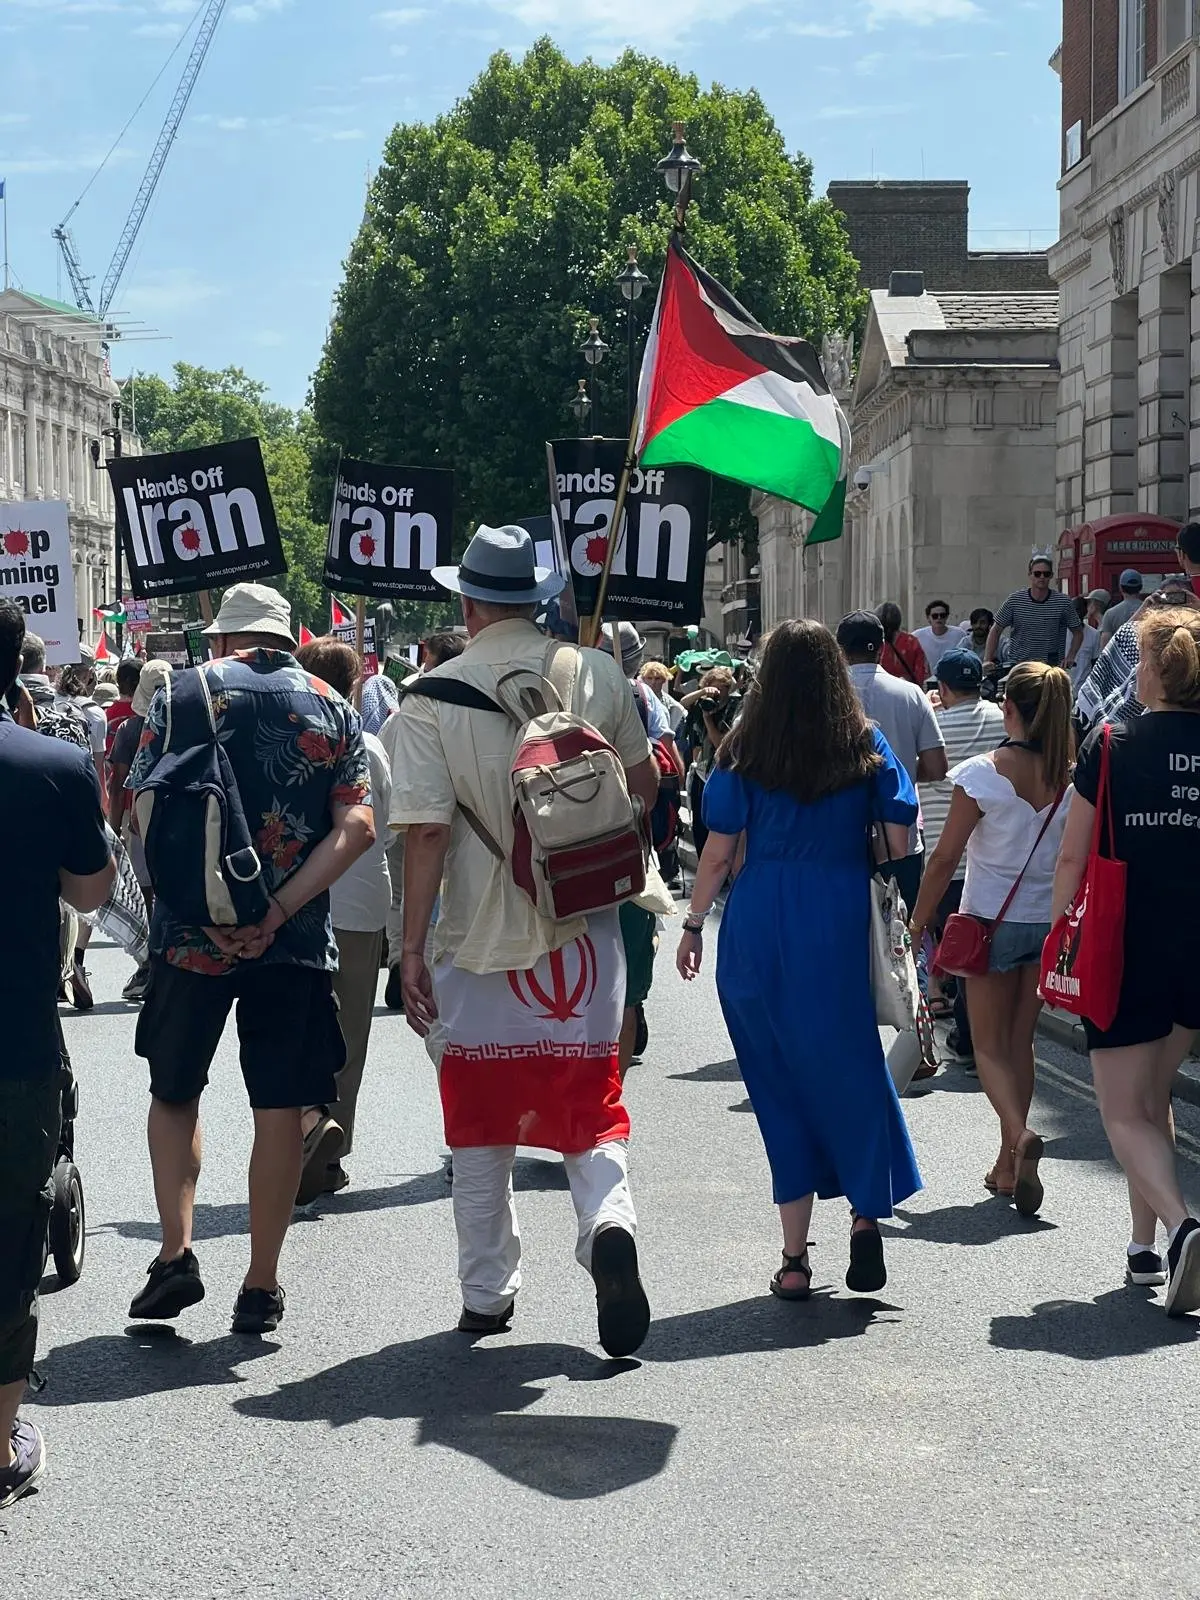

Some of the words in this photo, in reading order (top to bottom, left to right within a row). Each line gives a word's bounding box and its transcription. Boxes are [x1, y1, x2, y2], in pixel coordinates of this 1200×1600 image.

[136, 474, 188, 499] Hands
[191, 466, 224, 491] Off
[381, 486, 414, 507] Off
[122, 487, 266, 567] Iran
[1107, 541, 1176, 553] TELEPHONE
[206, 559, 270, 578] www.stopwar.org.uk
[372, 581, 437, 592] www.stopwar.org.uk
[607, 594, 684, 610] www.stopwar.org.uk
[336, 627, 373, 642] FREEM
[1169, 752, 1200, 773] IDF
[1171, 784, 1200, 801] are
